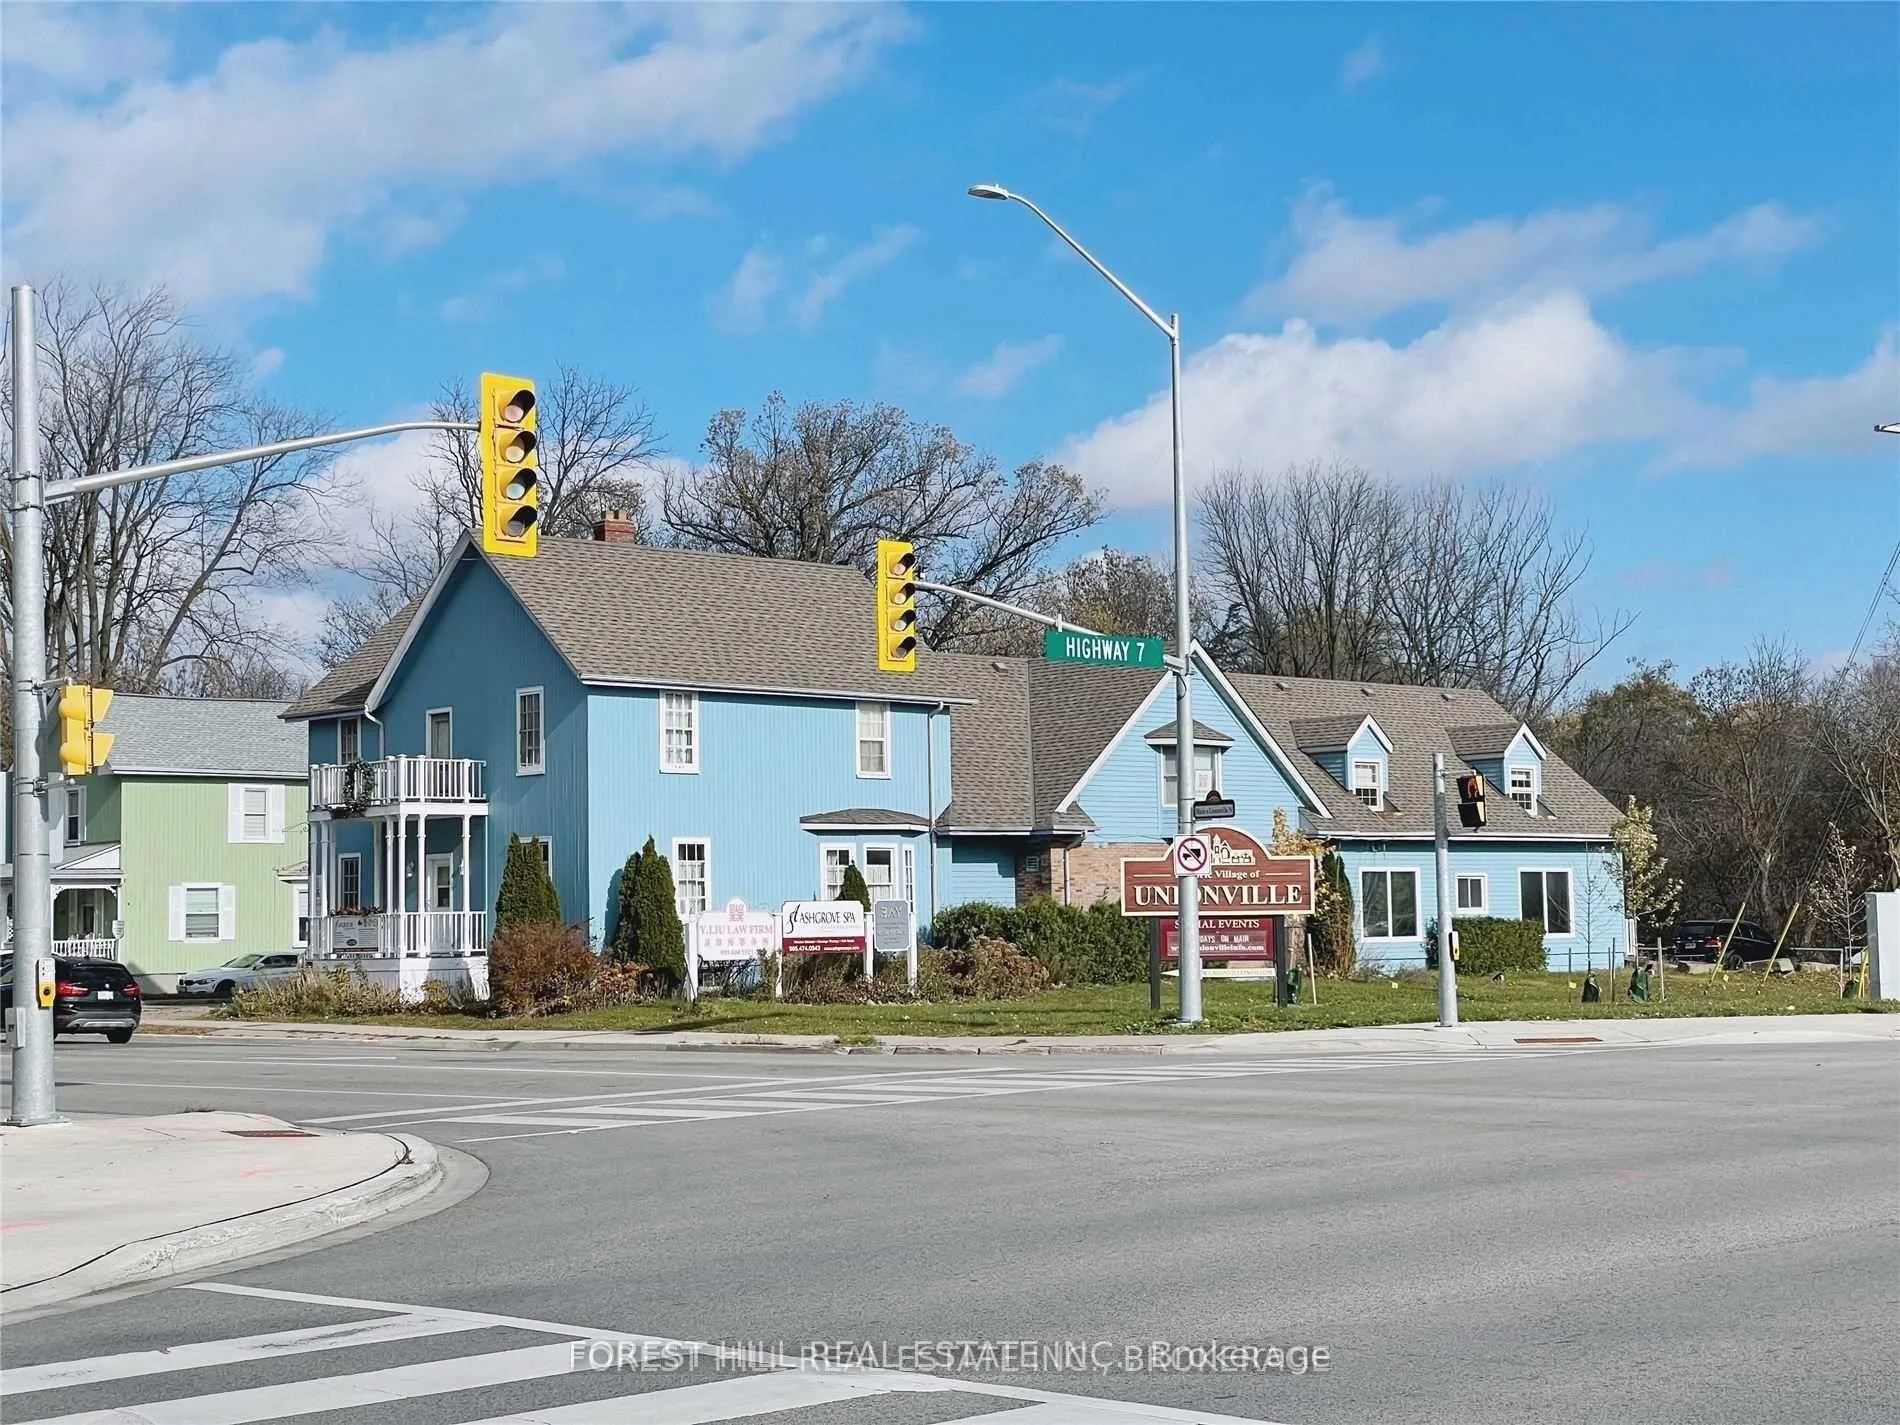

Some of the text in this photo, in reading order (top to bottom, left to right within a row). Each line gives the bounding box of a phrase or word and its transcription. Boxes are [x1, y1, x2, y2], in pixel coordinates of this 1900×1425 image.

[1066, 636, 1145, 662] HIGHWAY 7
[1214, 870, 1248, 880] Village
[1249, 870, 1260, 879] of
[1133, 884, 1303, 906] UNINVILLE
[800, 911, 856, 924] ASHGROVE SPA
[727, 925, 747, 934] LAW
[750, 925, 773, 934] FIRM
[1174, 919, 1261, 929] SIAL EVENTS
